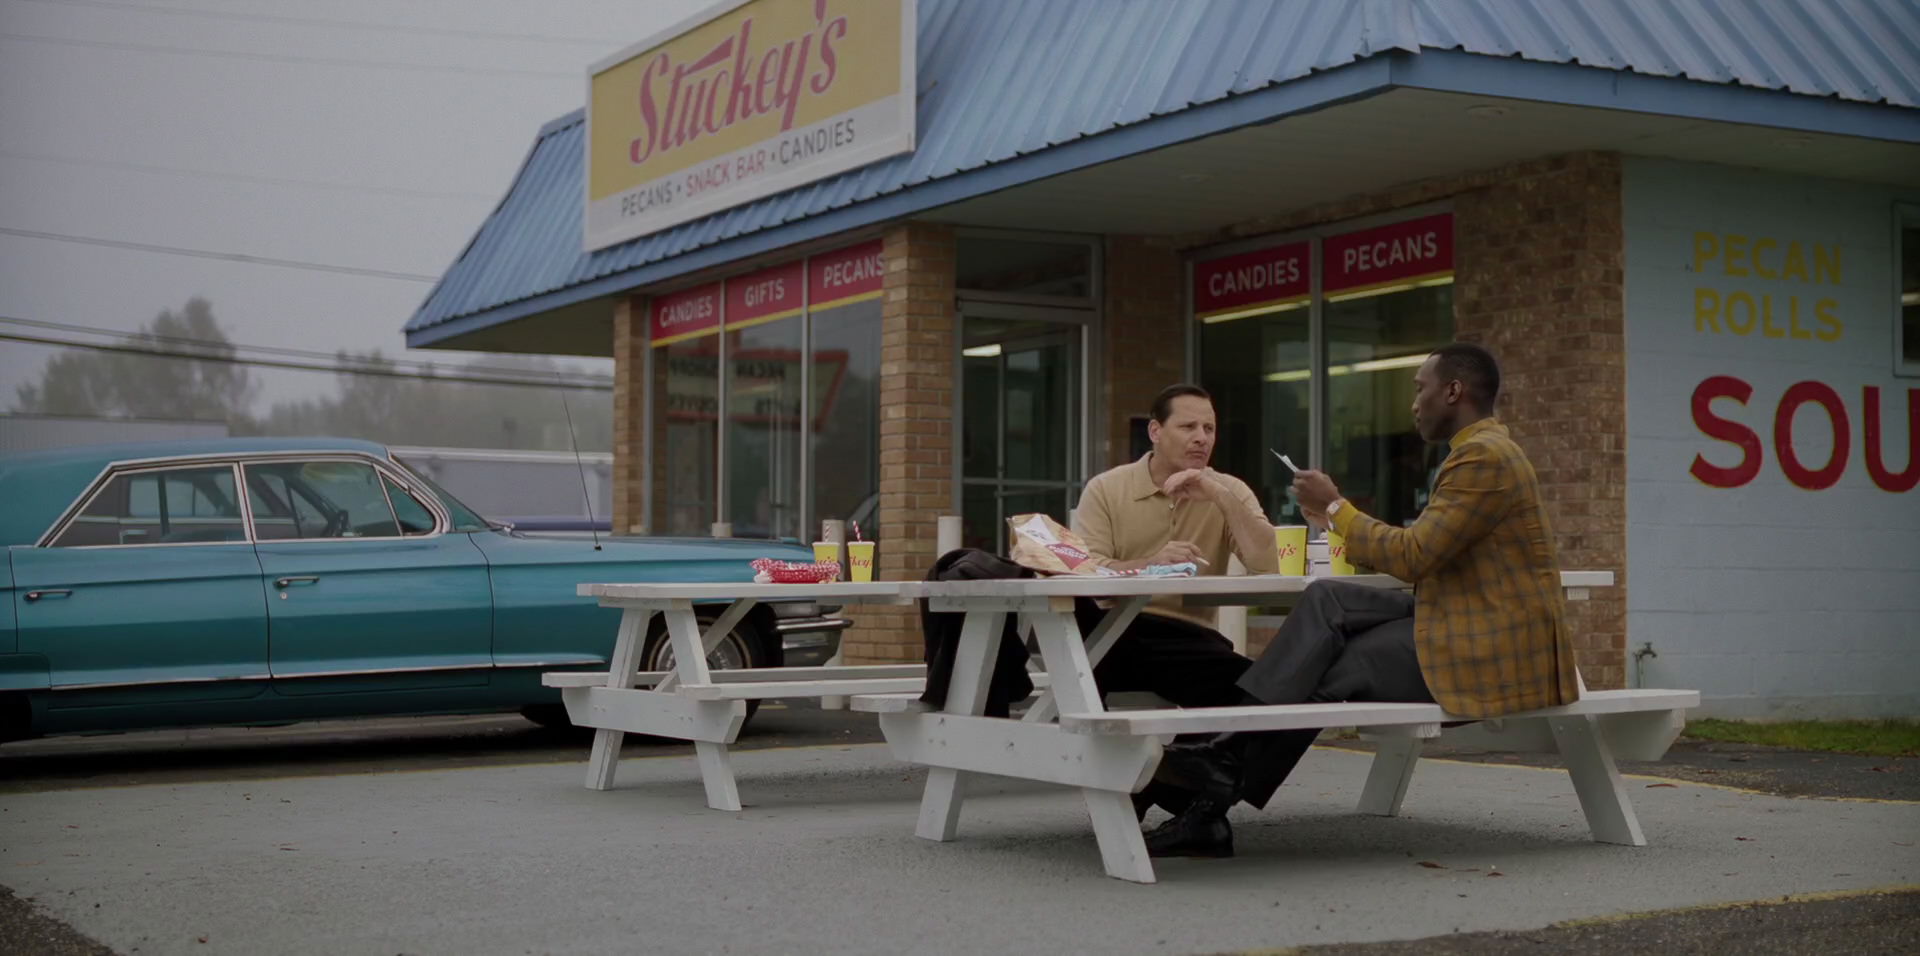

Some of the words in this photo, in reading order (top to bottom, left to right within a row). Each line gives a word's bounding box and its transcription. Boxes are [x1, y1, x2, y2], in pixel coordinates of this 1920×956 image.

[630, 0, 848, 164] Stuckey's
[620, 182, 673, 217] PECANS
[686, 163, 731, 198] SNACK
[736, 150, 766, 182] BAR
[779, 118, 856, 166] CANDIES
[659, 296, 713, 328] CANDIES
[744, 278, 785, 307] GIFTS
[823, 252, 885, 288] PECANS
[1208, 257, 1300, 297] CANDIES
[1343, 231, 1438, 274] PECANS
[1693, 231, 1841, 285] PECAN
[1694, 287, 1844, 342] ROLLS
[1689, 375, 1920, 493] SOU
